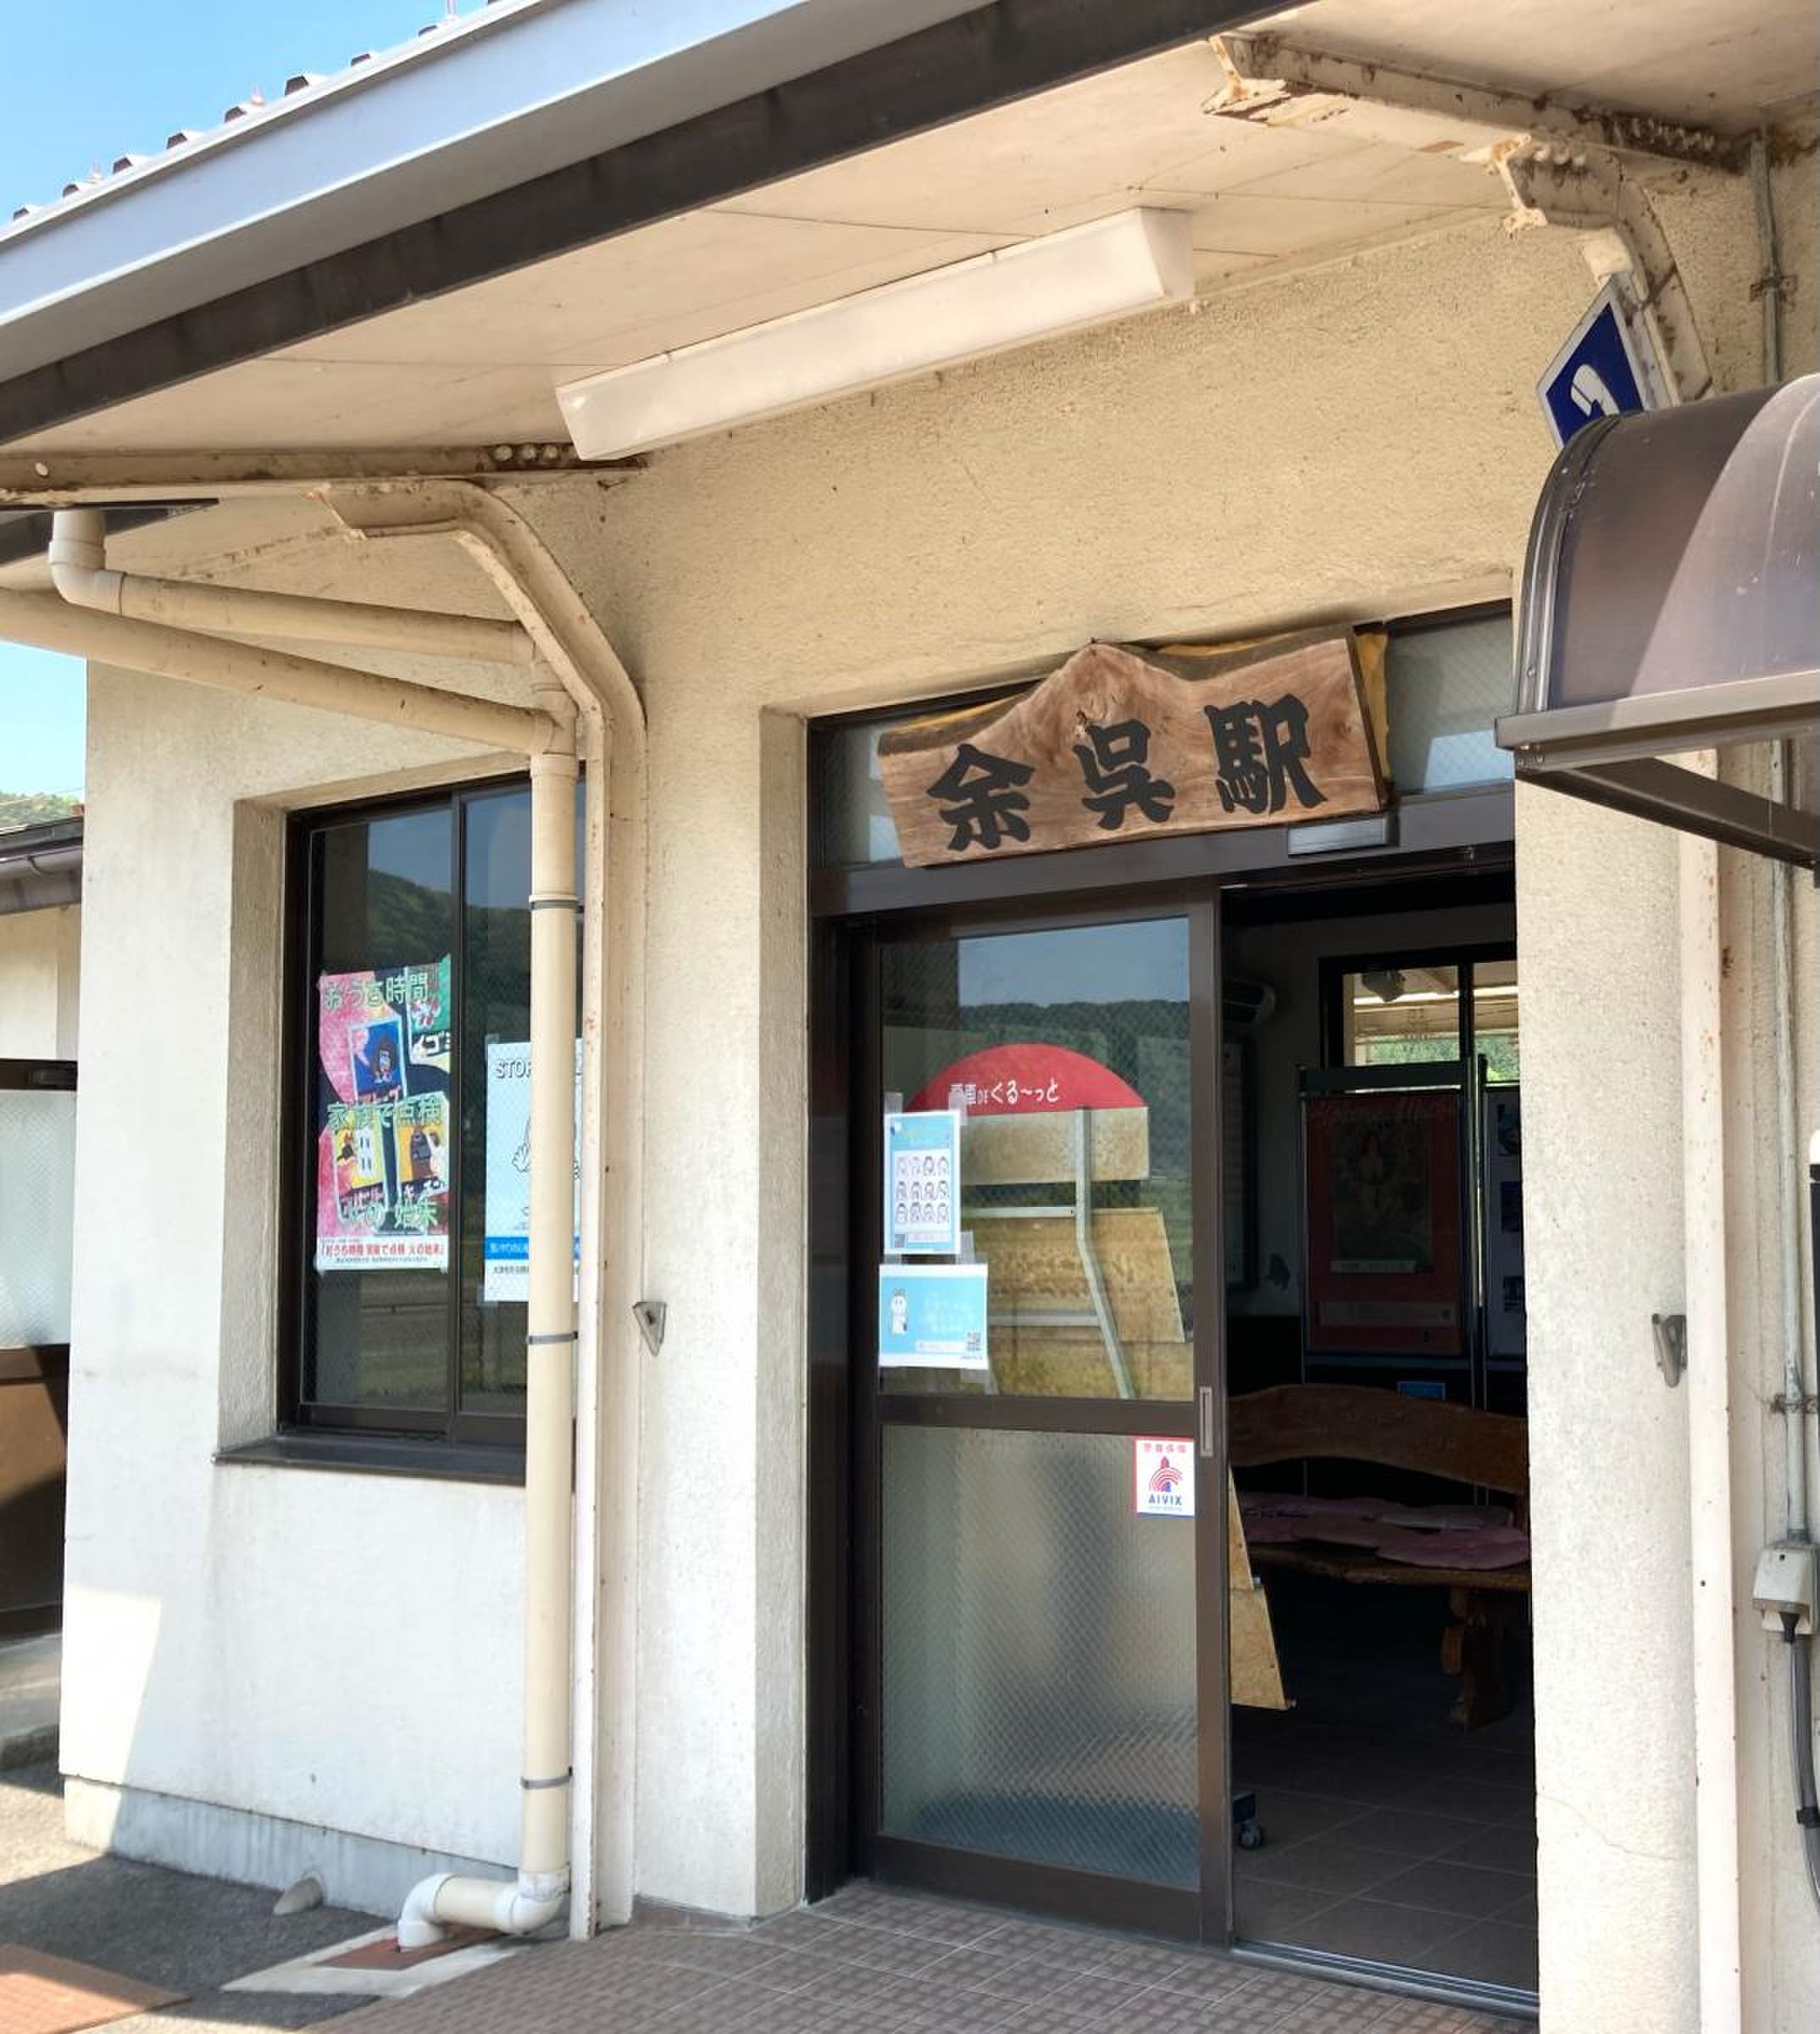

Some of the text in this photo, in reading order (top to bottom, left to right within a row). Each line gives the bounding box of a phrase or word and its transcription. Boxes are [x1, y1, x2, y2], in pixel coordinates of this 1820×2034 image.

[927, 695, 1328, 851] 余呉駅
[325, 972, 429, 1009] おうち時間
[496, 1058, 531, 1079] STO
[1148, 1493, 1182, 1506] AIVIX
